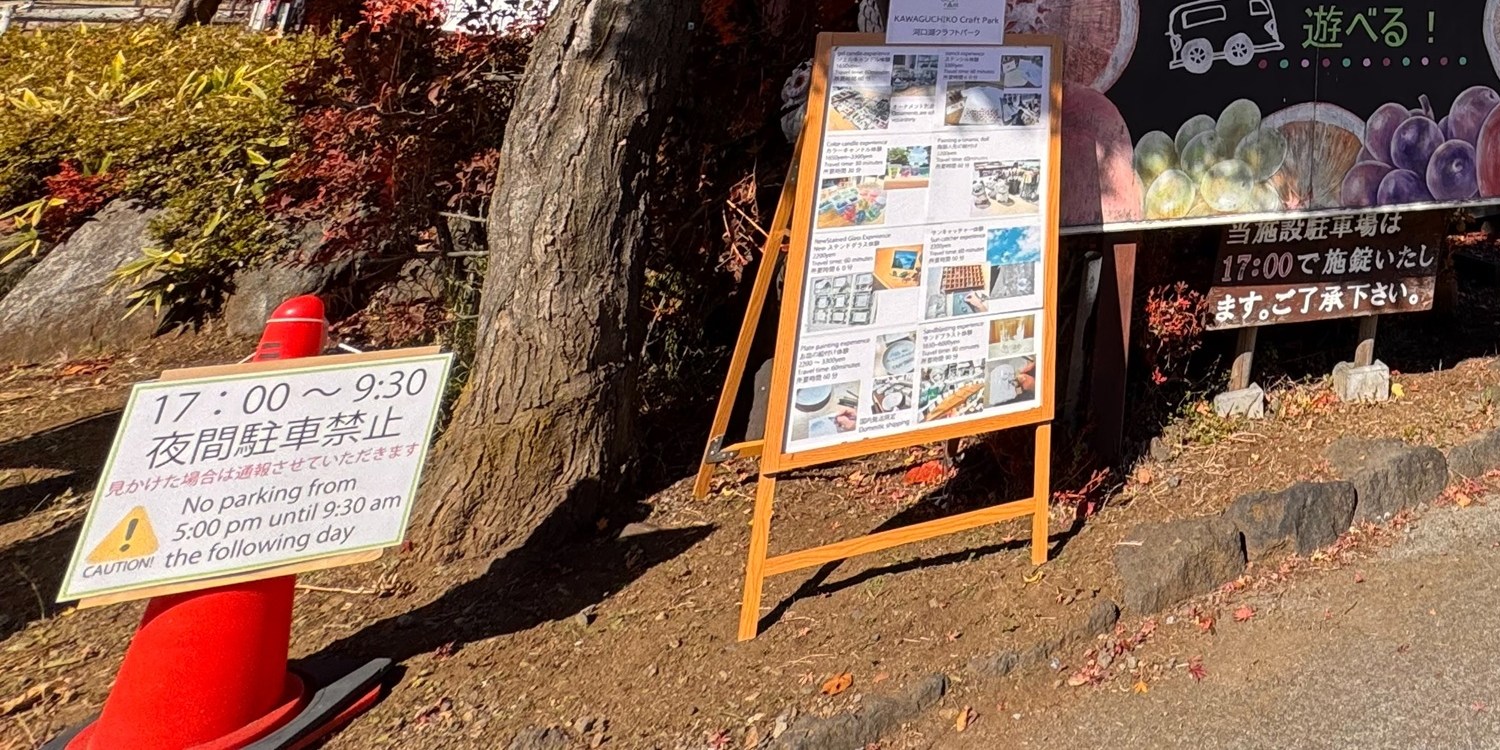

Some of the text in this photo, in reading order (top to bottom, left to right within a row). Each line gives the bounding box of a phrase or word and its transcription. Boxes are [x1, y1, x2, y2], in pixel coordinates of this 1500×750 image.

[894, 15, 957, 24] KAWAGUCHIKO
[960, 16, 980, 24] Craft
[1226, 212, 1402, 245] 当施設駐車場は
[1215, 281, 1419, 322] ます。ご了承下さい。
[353, 368, 428, 402] 9:30
[146, 405, 403, 470] 夜間駐車禁止
[105, 442, 420, 498] 見かけた場合は通報させていただきます
[181, 478, 357, 515] No parking from
[172, 495, 402, 542] 5:00 pm until 9:30 am
[165, 524, 356, 569] the following day
[82, 557, 155, 579] CAUTION!
